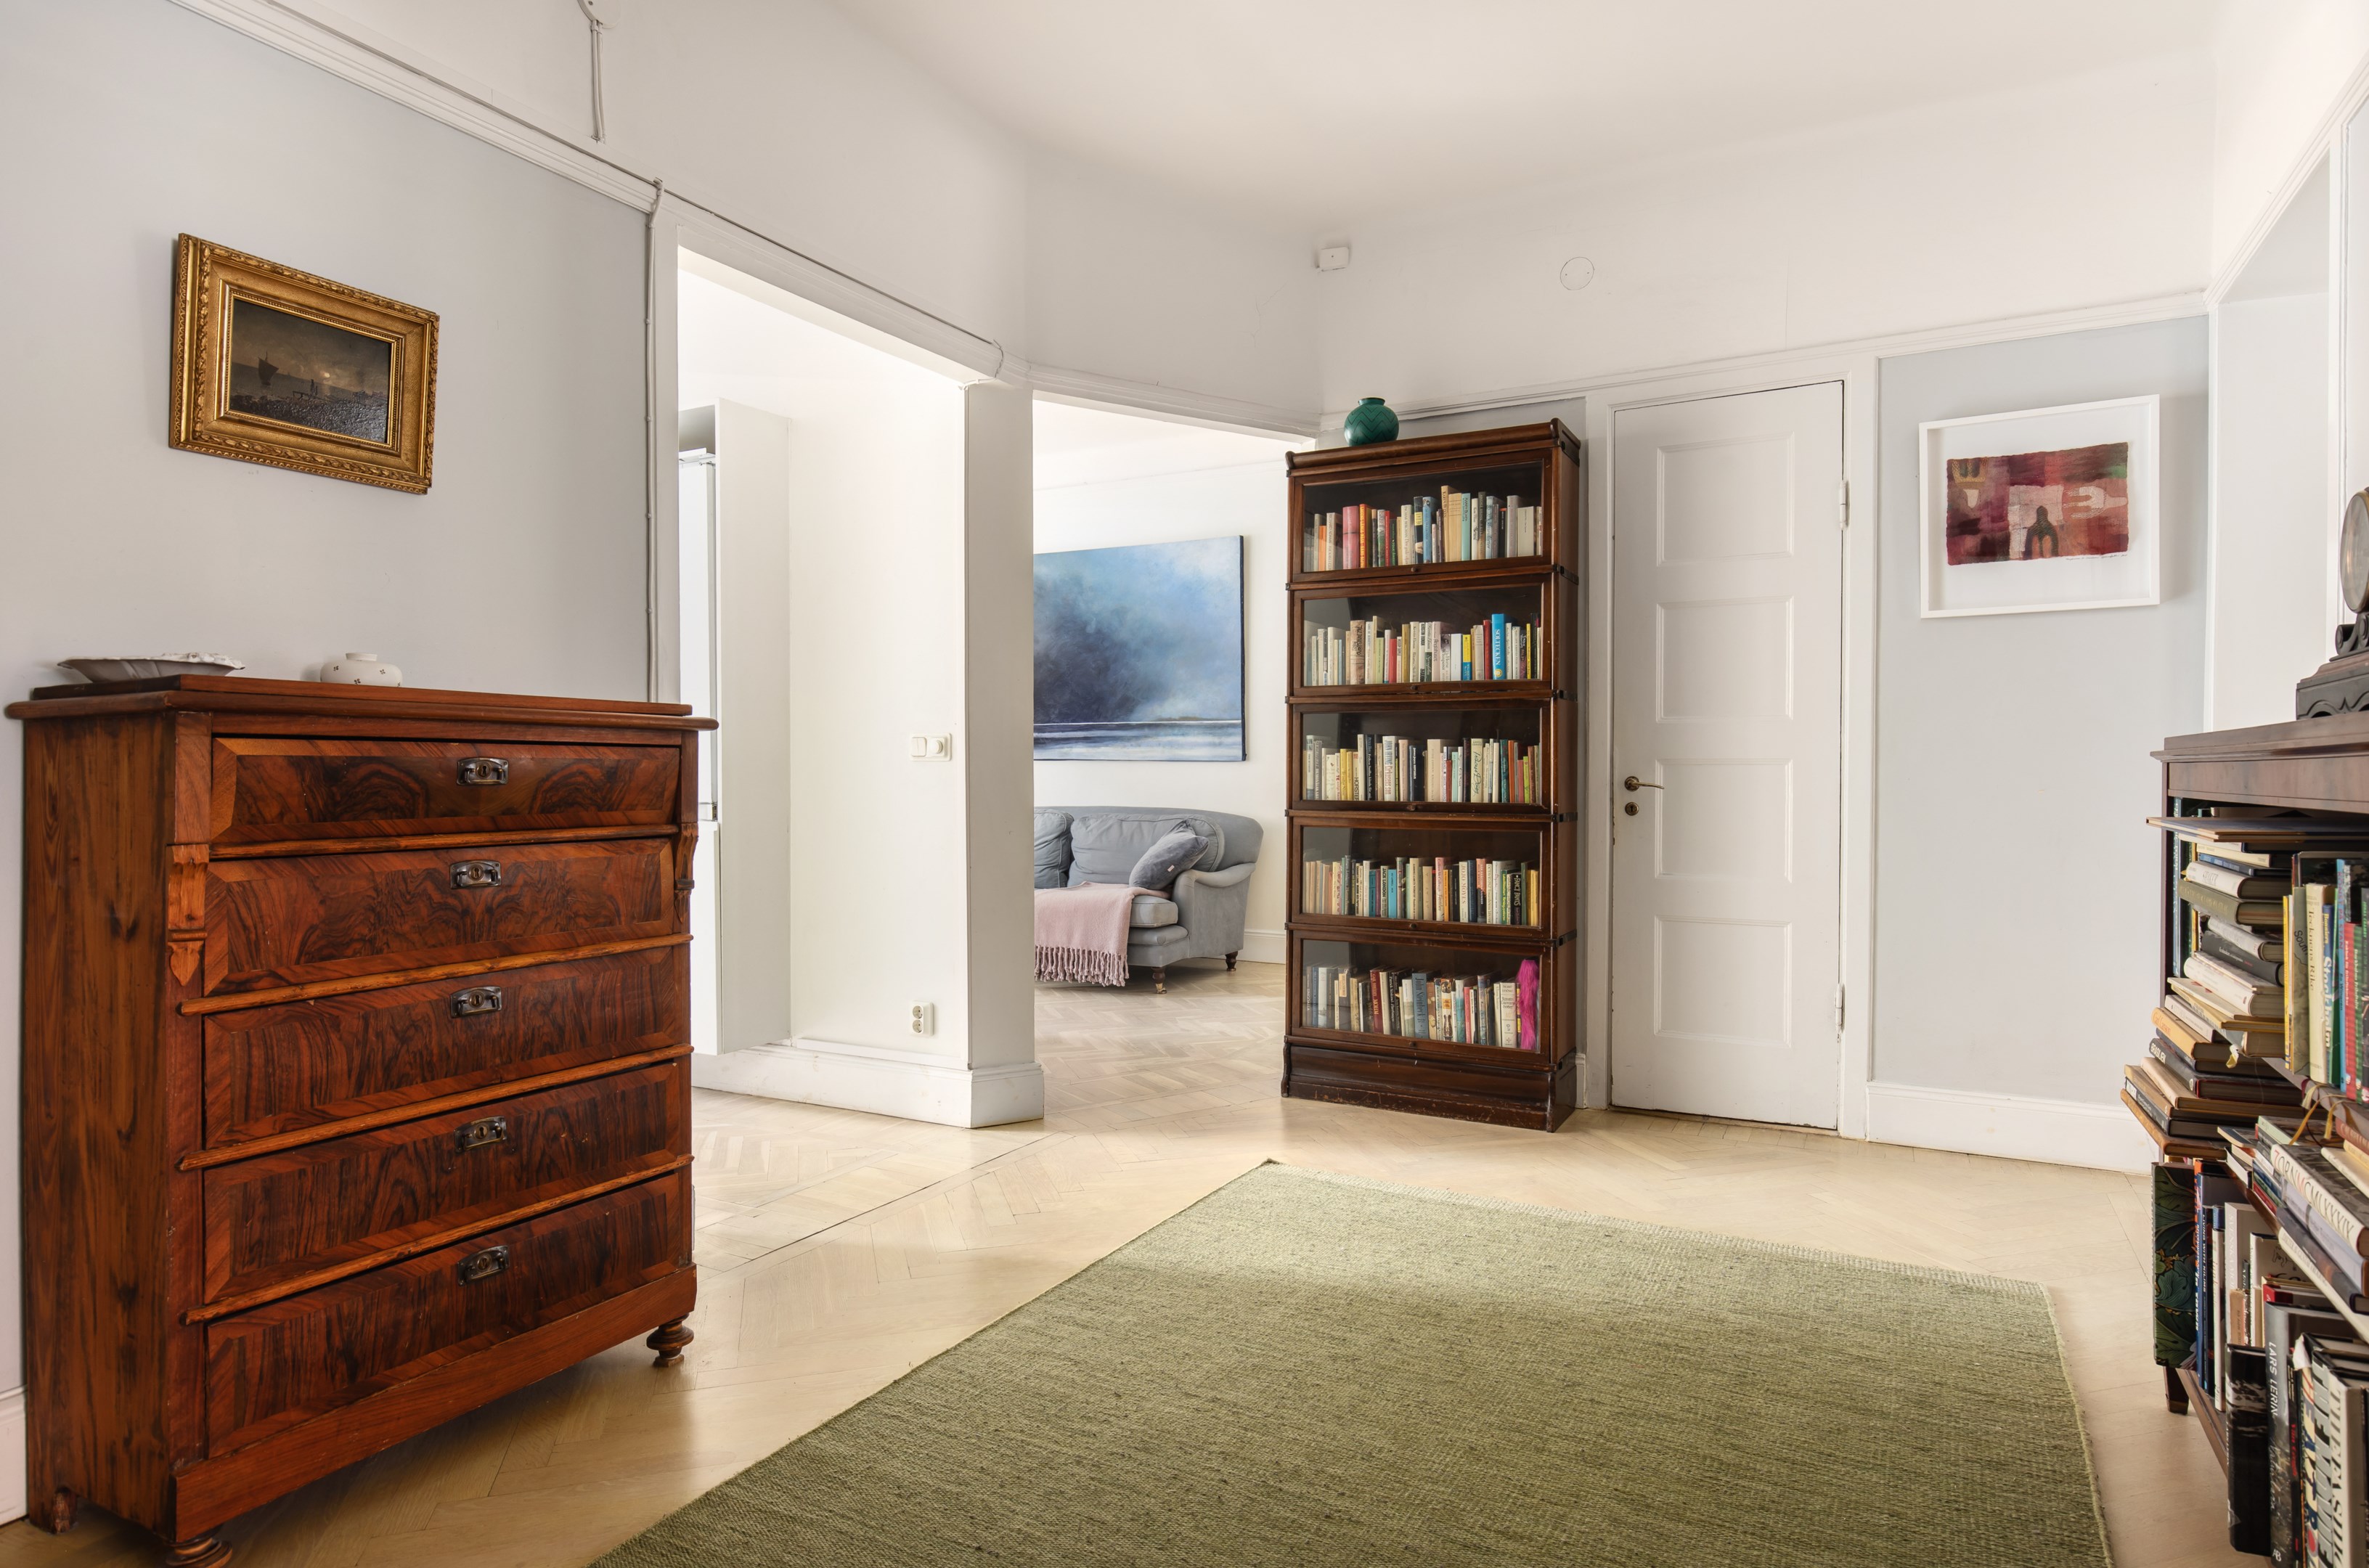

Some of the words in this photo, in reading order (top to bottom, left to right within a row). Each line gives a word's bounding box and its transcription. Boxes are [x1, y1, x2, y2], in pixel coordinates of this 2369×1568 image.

[2338, 908, 2345, 920] PÅ
[2293, 929, 2308, 955] South
[1414, 978, 1424, 991] John
[1416, 992, 1426, 1016] Steinbeck
[2323, 956, 2332, 1049] Stockholm
[2274, 1149, 2299, 1188] ZORN
[2268, 1342, 2278, 1375] LARS
[2270, 1379, 2278, 1417] LERIN
[2315, 1440, 2333, 1567] MOVIE
